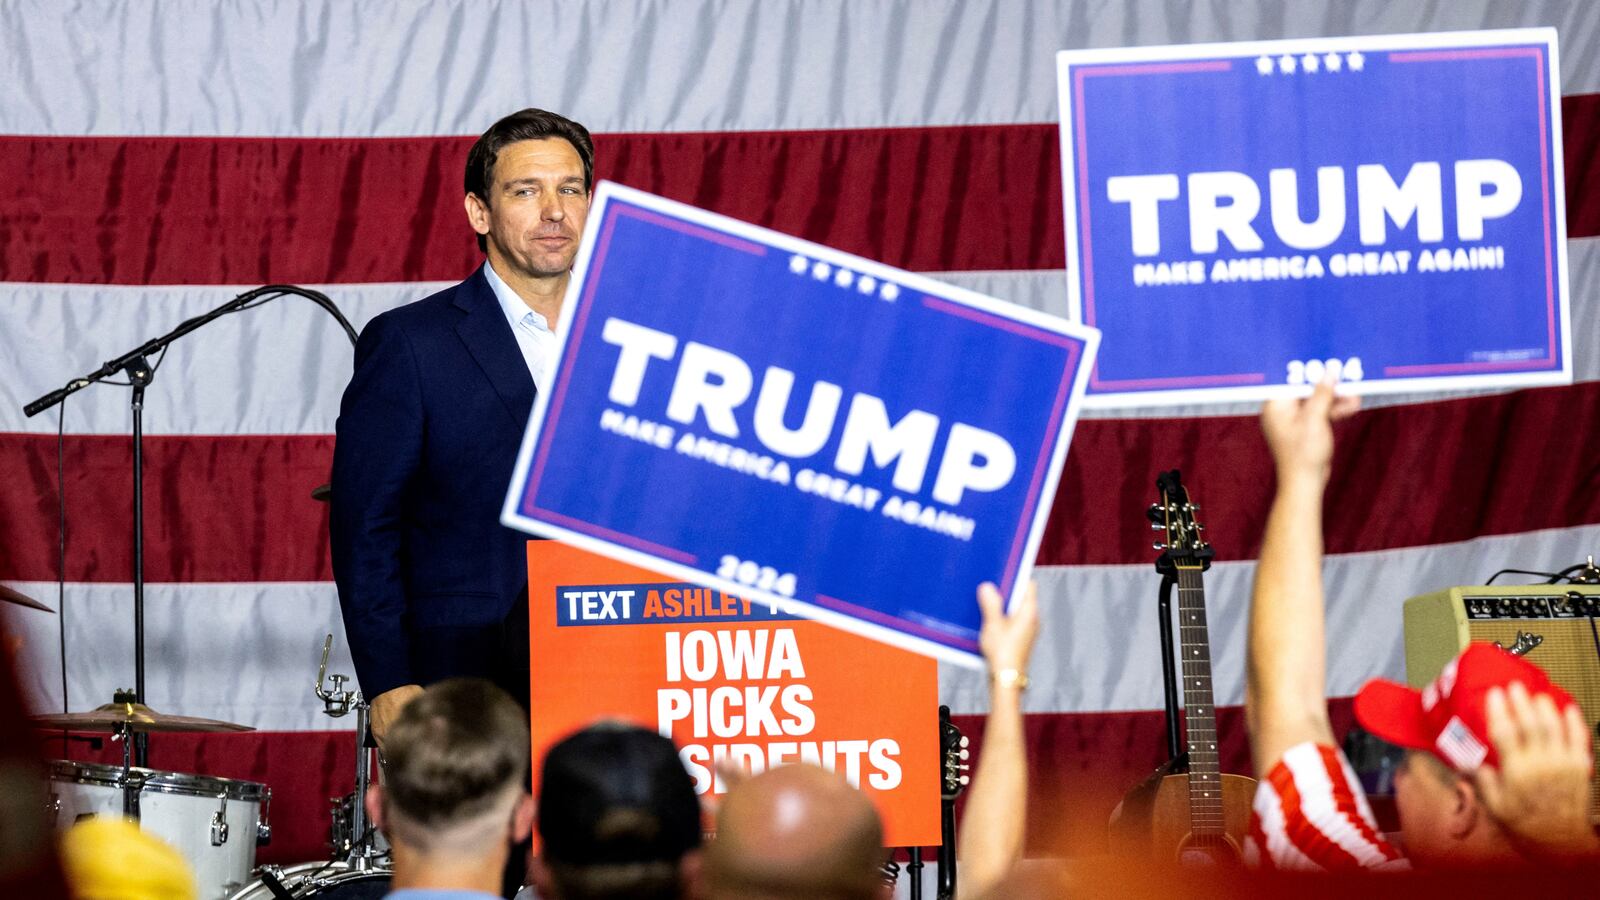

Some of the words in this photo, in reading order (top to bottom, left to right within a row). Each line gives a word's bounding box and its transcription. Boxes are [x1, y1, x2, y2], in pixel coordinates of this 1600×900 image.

[1106, 159, 1523, 257] TRUMP
[1133, 261, 1206, 287] MAKE
[1210, 254, 1325, 283] AMERICA
[1329, 250, 1412, 277] GREAT
[1417, 245, 1505, 273] AGAIN!
[603, 317, 1017, 506] TRUMP
[601, 409, 675, 449] MAKE
[675, 432, 791, 485] AMERICA
[795, 468, 881, 511] GREAT
[882, 496, 975, 541] AGAIN!
[563, 590, 635, 620] TEXT
[643, 586, 752, 618] ASHLEY
[716, 554, 798, 598] 2024
[665, 628, 806, 682] IOWA
[657, 684, 816, 739] PICKS
[679, 738, 902, 795] SIDENTS
